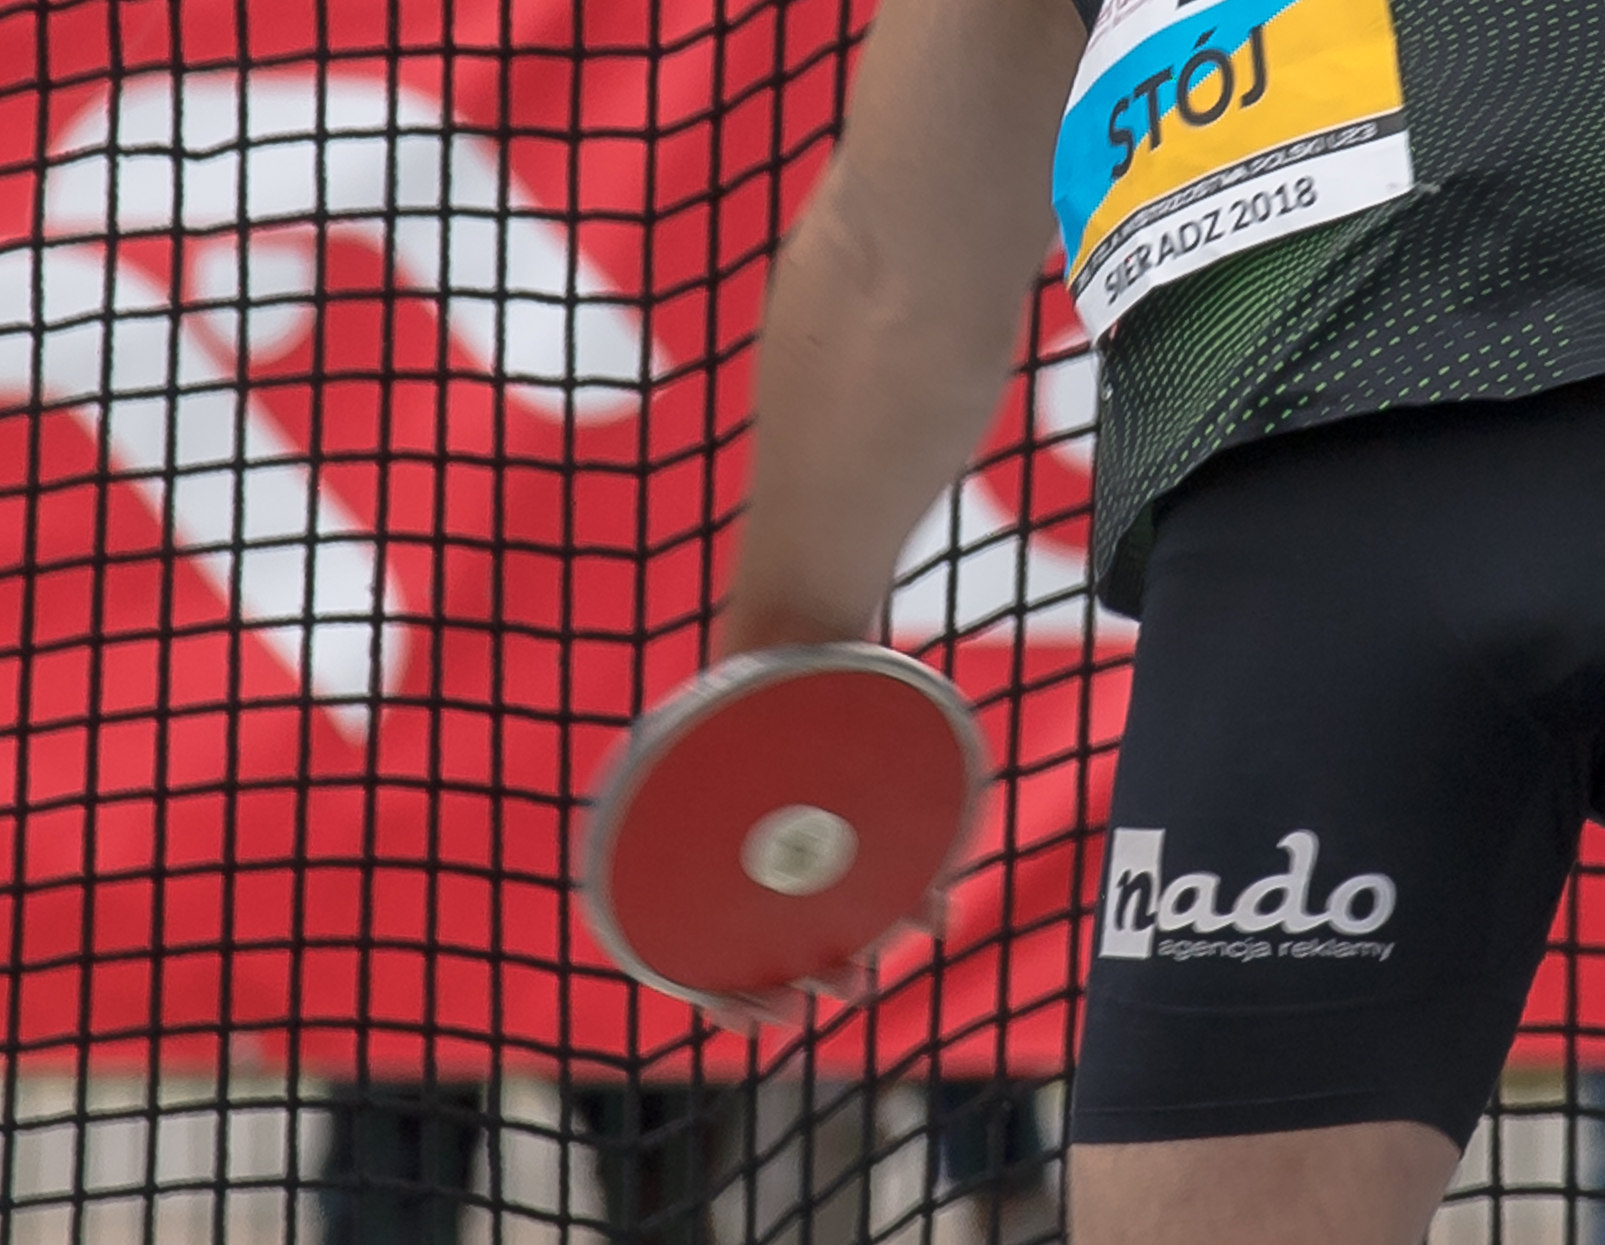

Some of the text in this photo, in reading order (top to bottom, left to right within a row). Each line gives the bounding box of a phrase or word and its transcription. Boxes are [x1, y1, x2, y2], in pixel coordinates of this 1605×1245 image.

[1107, 25, 1269, 181] STÓJ
[1104, 208, 1226, 306] SIERADZ
[1230, 175, 1318, 234] 2018
[1157, 937, 1395, 962] agencja reklamy
